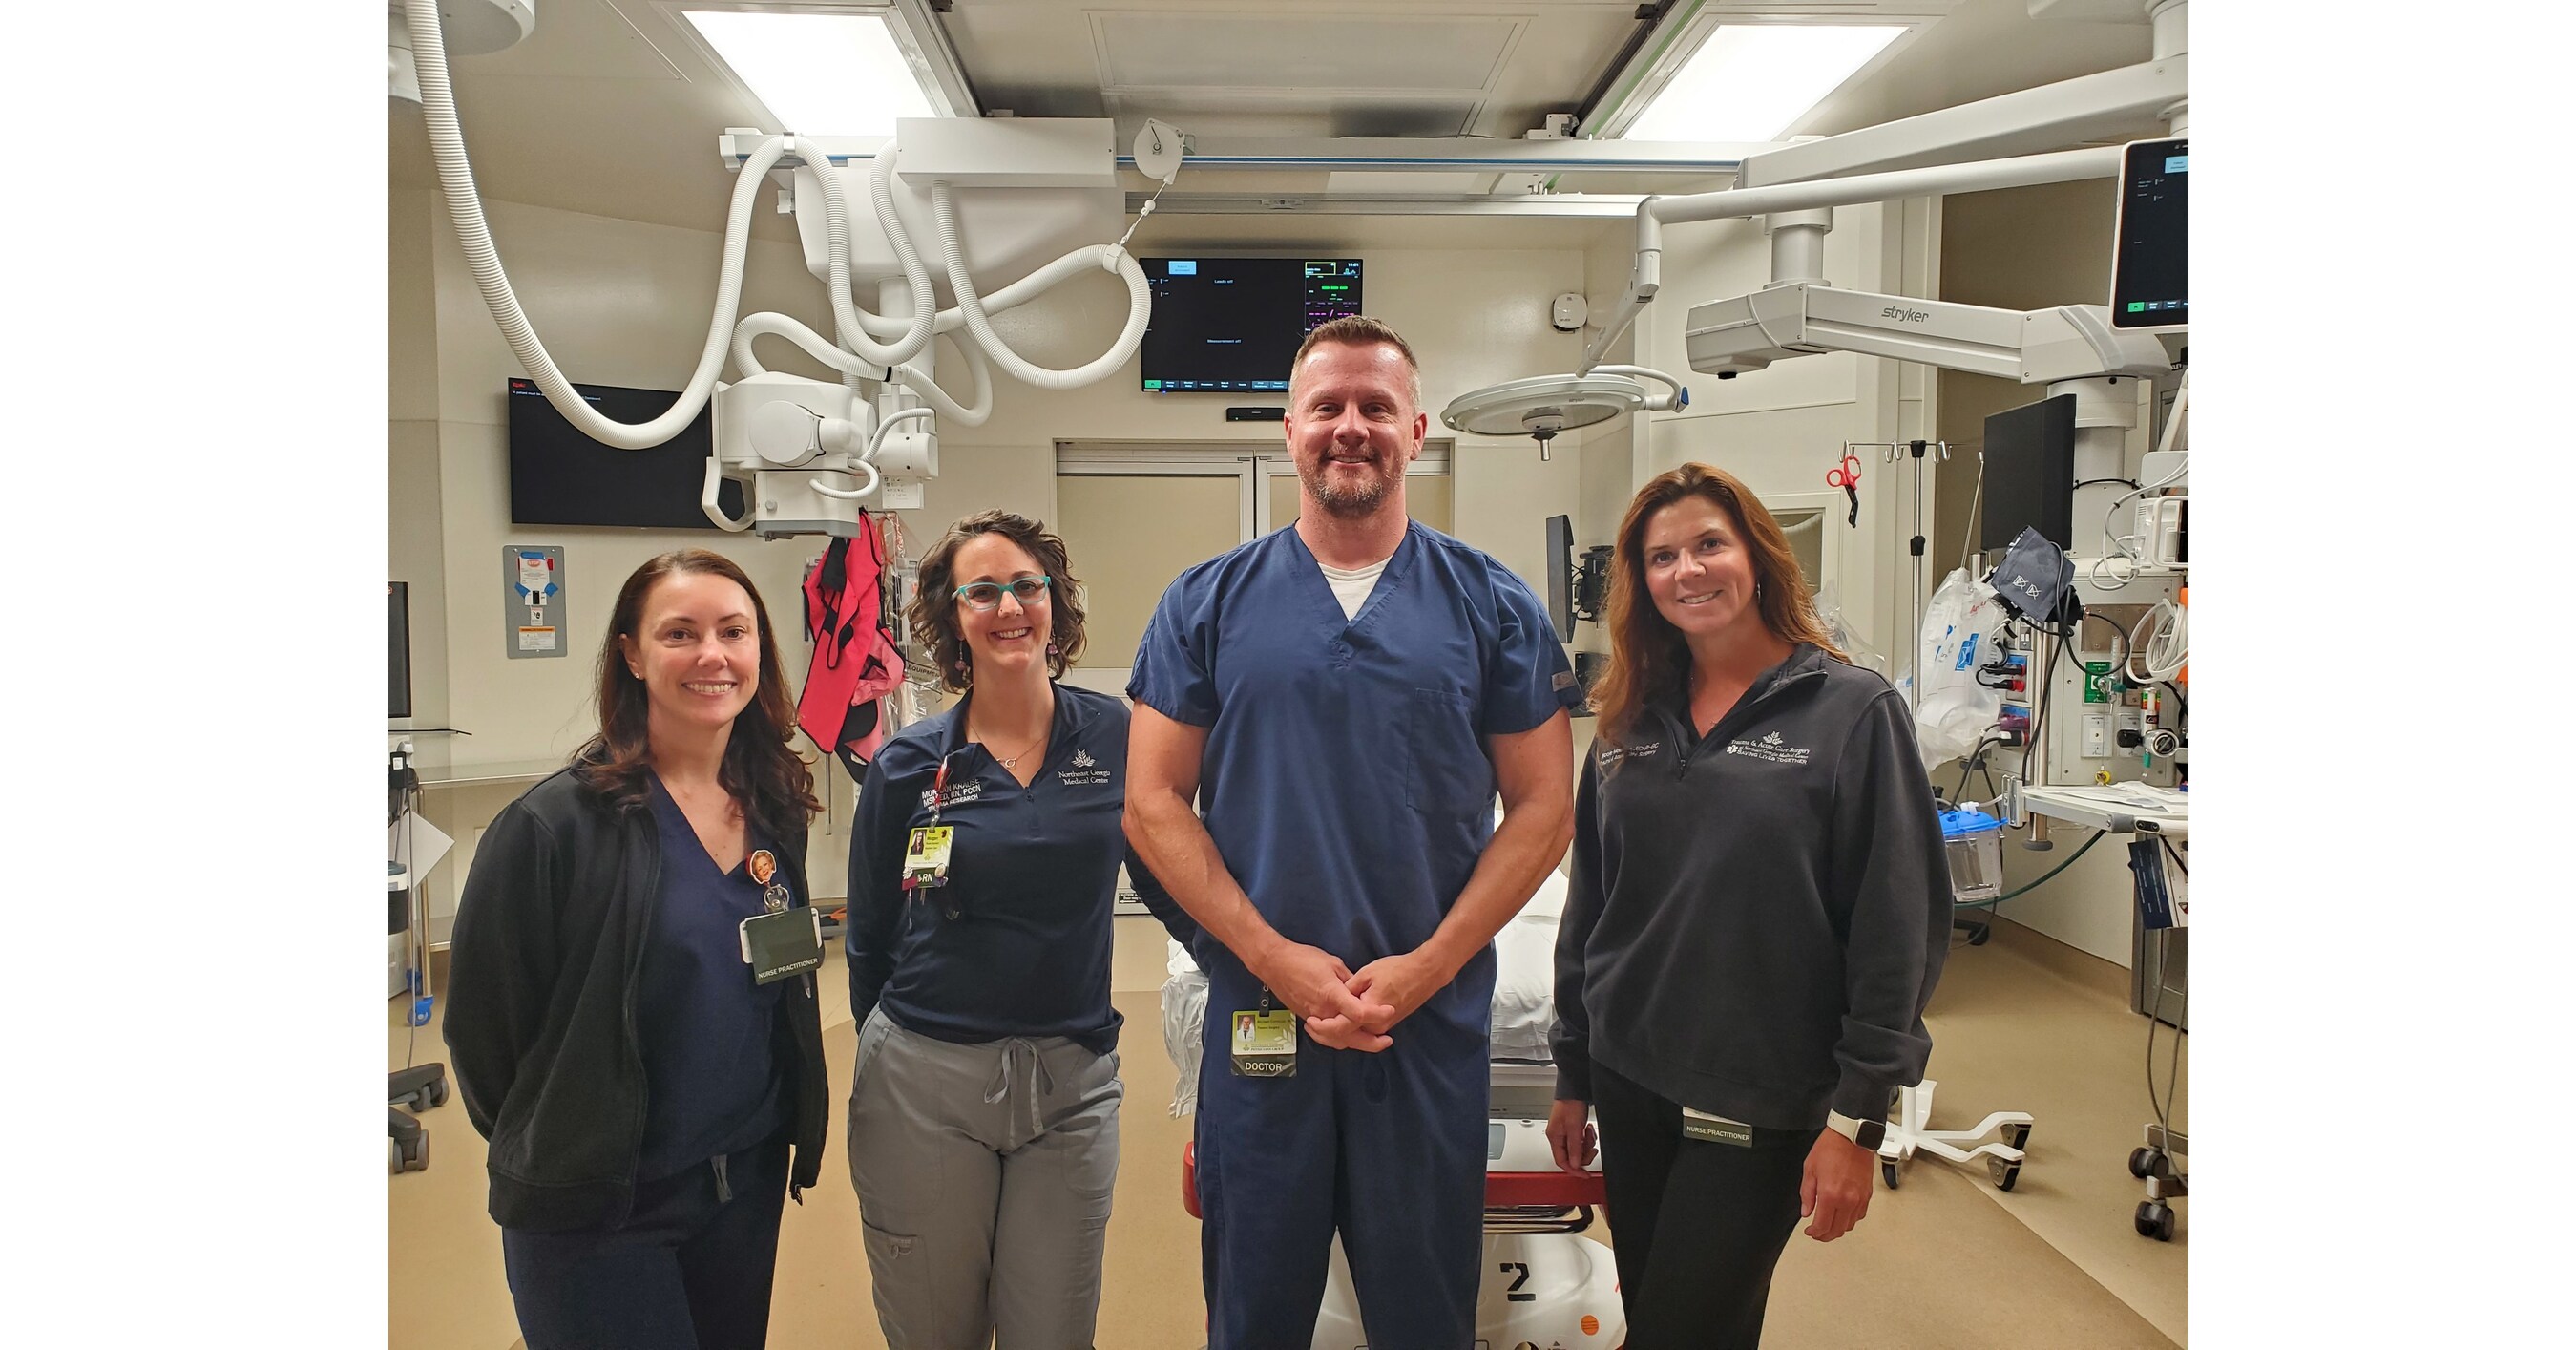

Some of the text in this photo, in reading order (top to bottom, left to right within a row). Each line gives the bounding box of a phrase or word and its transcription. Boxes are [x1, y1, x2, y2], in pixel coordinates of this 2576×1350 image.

[1881, 306, 1929, 323] stryker
[1757, 741, 1774, 749] Acute
[1789, 747, 1810, 755] Surgery
[953, 779, 980, 791] KRAUSE
[1062, 777, 1089, 786] Medical
[963, 784, 982, 795] PCCN
[949, 793, 979, 805] RESEARCH
[758, 958, 818, 980] NURSE PRACTITIONER
[1245, 1062, 1283, 1071] DOCTOR
[1686, 1126, 1750, 1142] NURSE PRACTITIONER
[1499, 1262, 1536, 1301] 2
